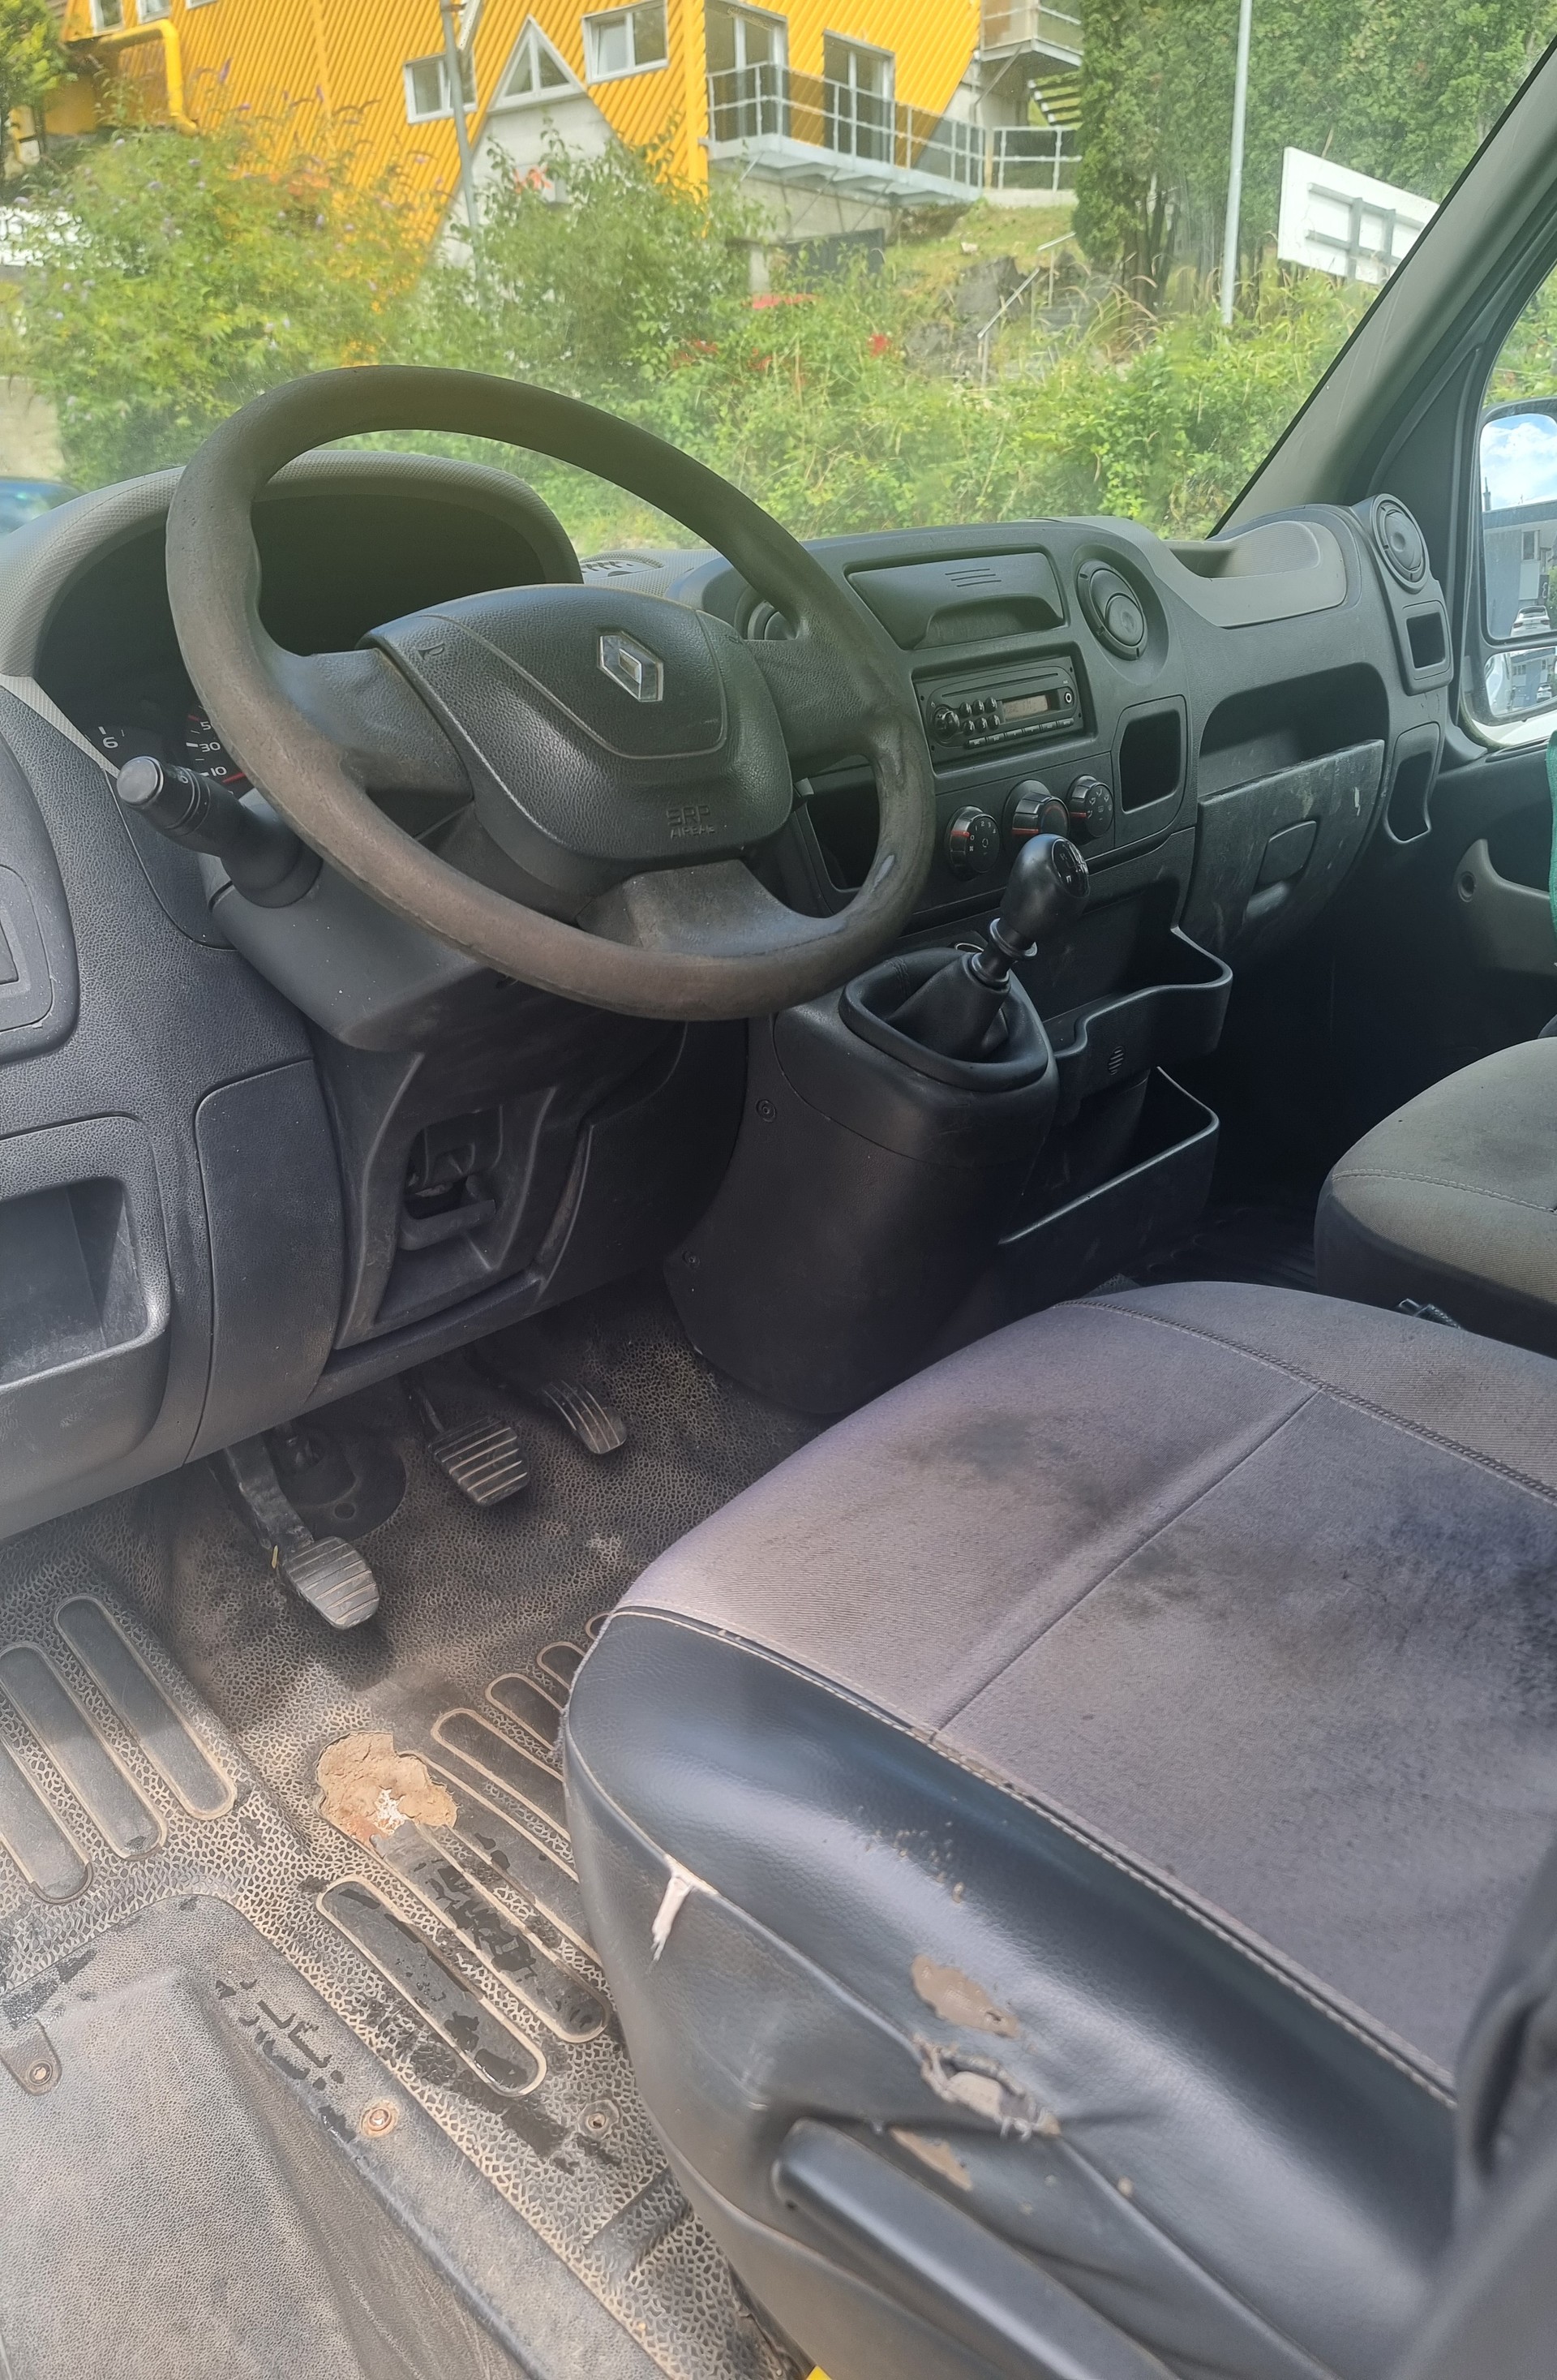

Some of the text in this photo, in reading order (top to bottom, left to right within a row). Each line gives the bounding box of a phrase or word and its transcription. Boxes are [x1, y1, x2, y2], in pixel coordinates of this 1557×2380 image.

[103, 737, 118, 749] 6
[199, 741, 221, 753] 30
[210, 766, 227, 776] 10
